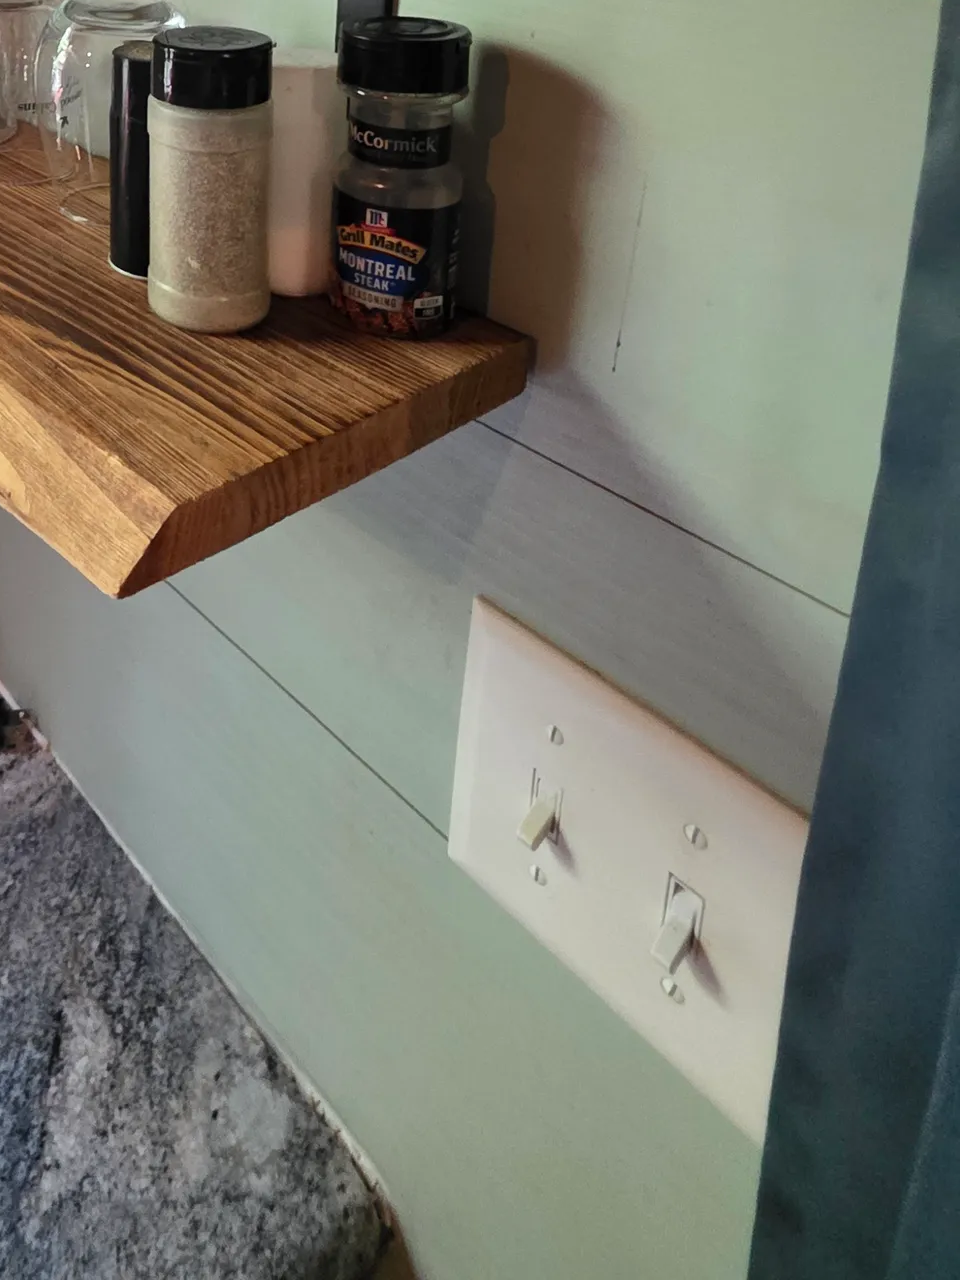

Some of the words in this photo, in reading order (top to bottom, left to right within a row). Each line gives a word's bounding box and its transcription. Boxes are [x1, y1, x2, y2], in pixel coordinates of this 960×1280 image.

[339, 227, 365, 245] Grill
[369, 233, 419, 258] Mates
[339, 247, 416, 282] MONTREAL
[353, 272, 389, 291] STEAK
[348, 285, 397, 308] SEASONING
